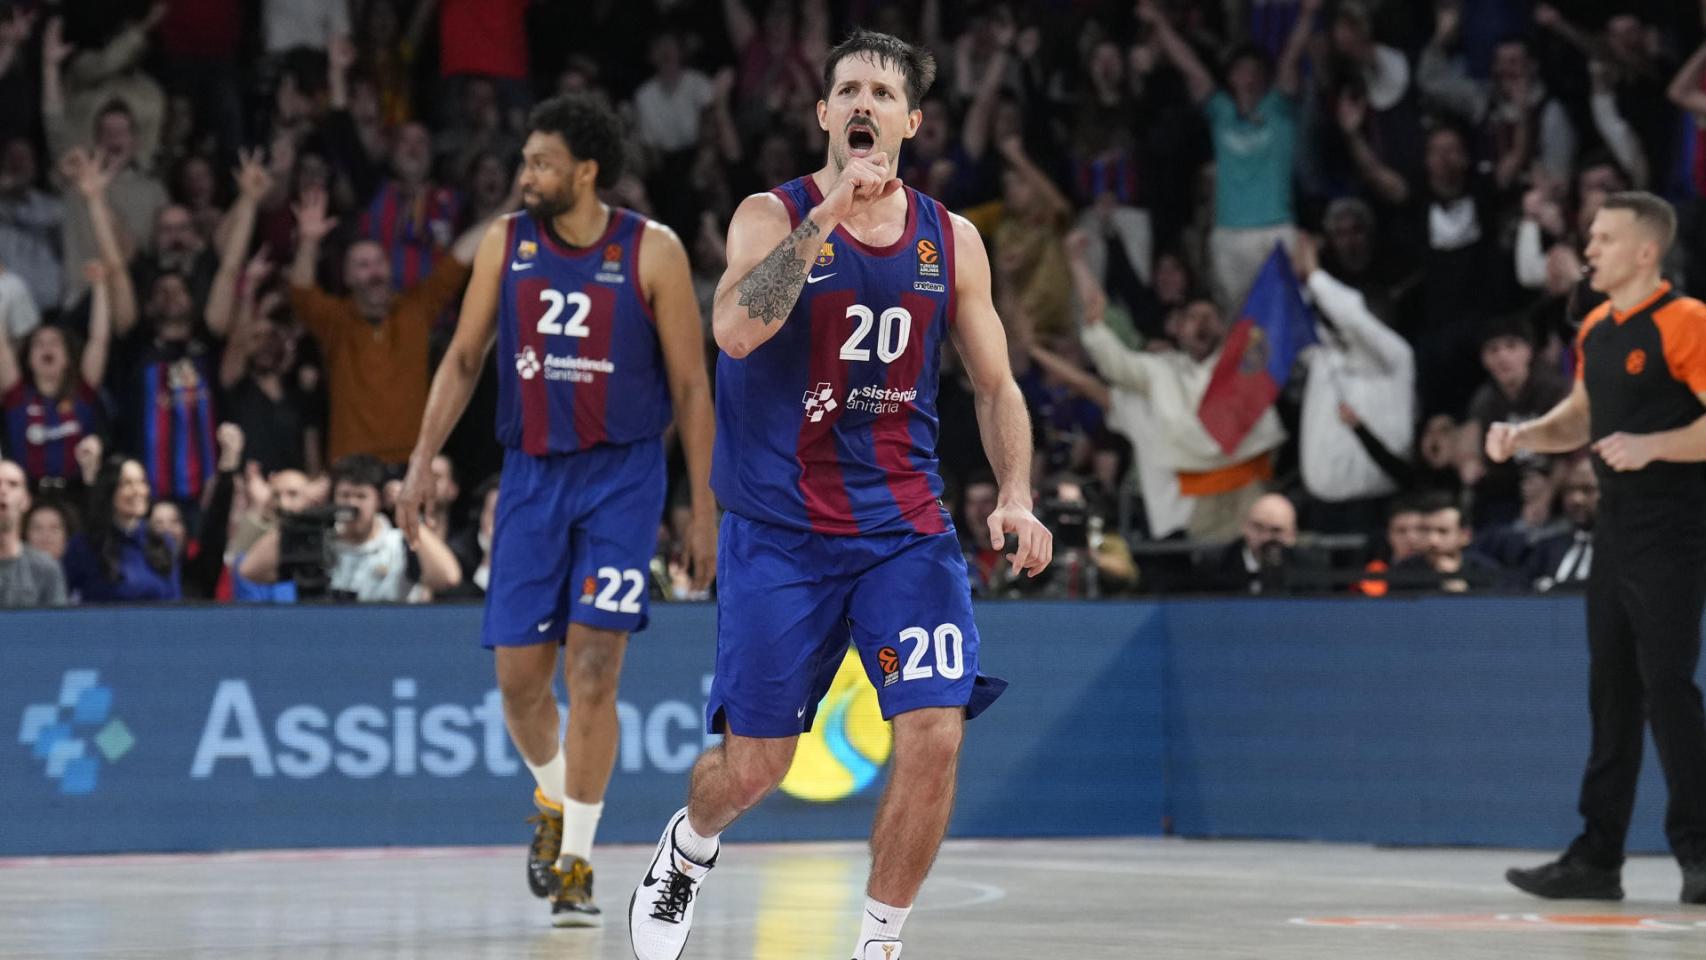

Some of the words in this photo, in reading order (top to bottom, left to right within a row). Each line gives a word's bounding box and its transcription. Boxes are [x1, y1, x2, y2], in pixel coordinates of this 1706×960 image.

[536, 289, 592, 338] 22
[839, 304, 912, 364] 20
[846, 384, 918, 403] Asistència
[846, 399, 900, 414] anitària
[594, 566, 645, 614] 22
[899, 623, 964, 680] 20
[190, 677, 725, 779] Assistnc
